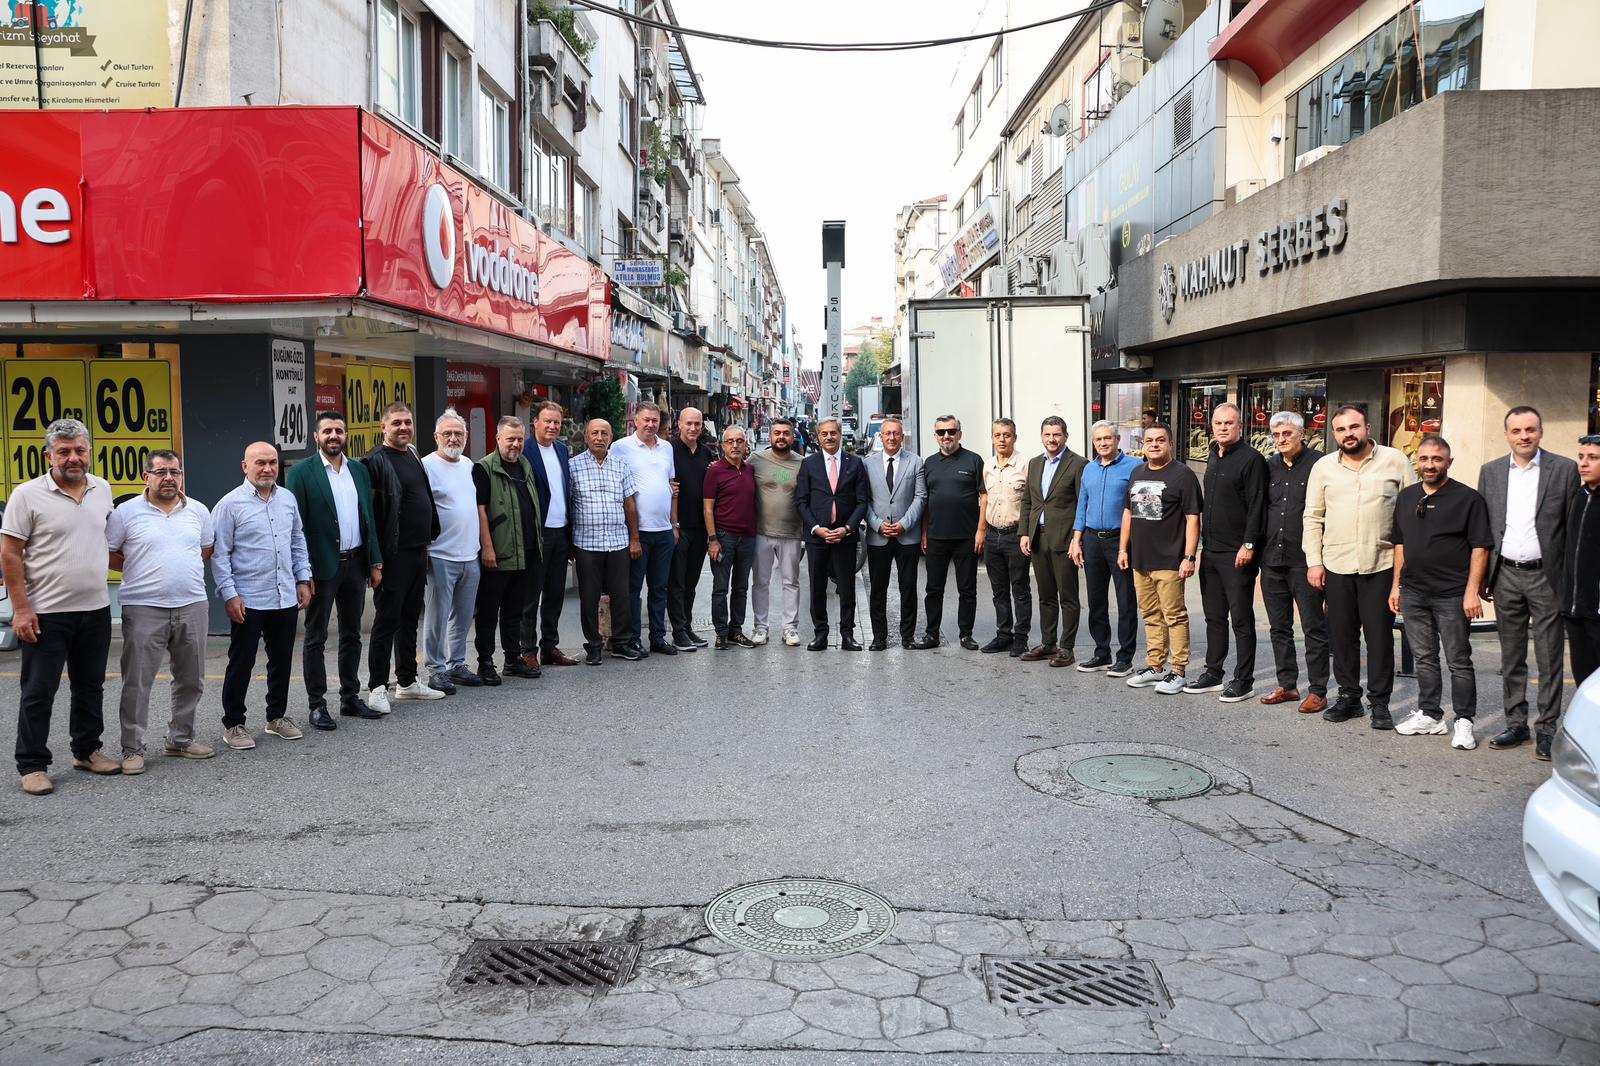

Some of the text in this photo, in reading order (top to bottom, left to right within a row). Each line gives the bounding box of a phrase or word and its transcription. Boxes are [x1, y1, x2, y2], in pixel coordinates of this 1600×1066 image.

[0, 31, 80, 45] izm Seyahat
[35, 80, 97, 88] Organizasyonları
[1179, 196, 1348, 298] MAHMUT SERBES
[466, 239, 539, 306] vodafone
